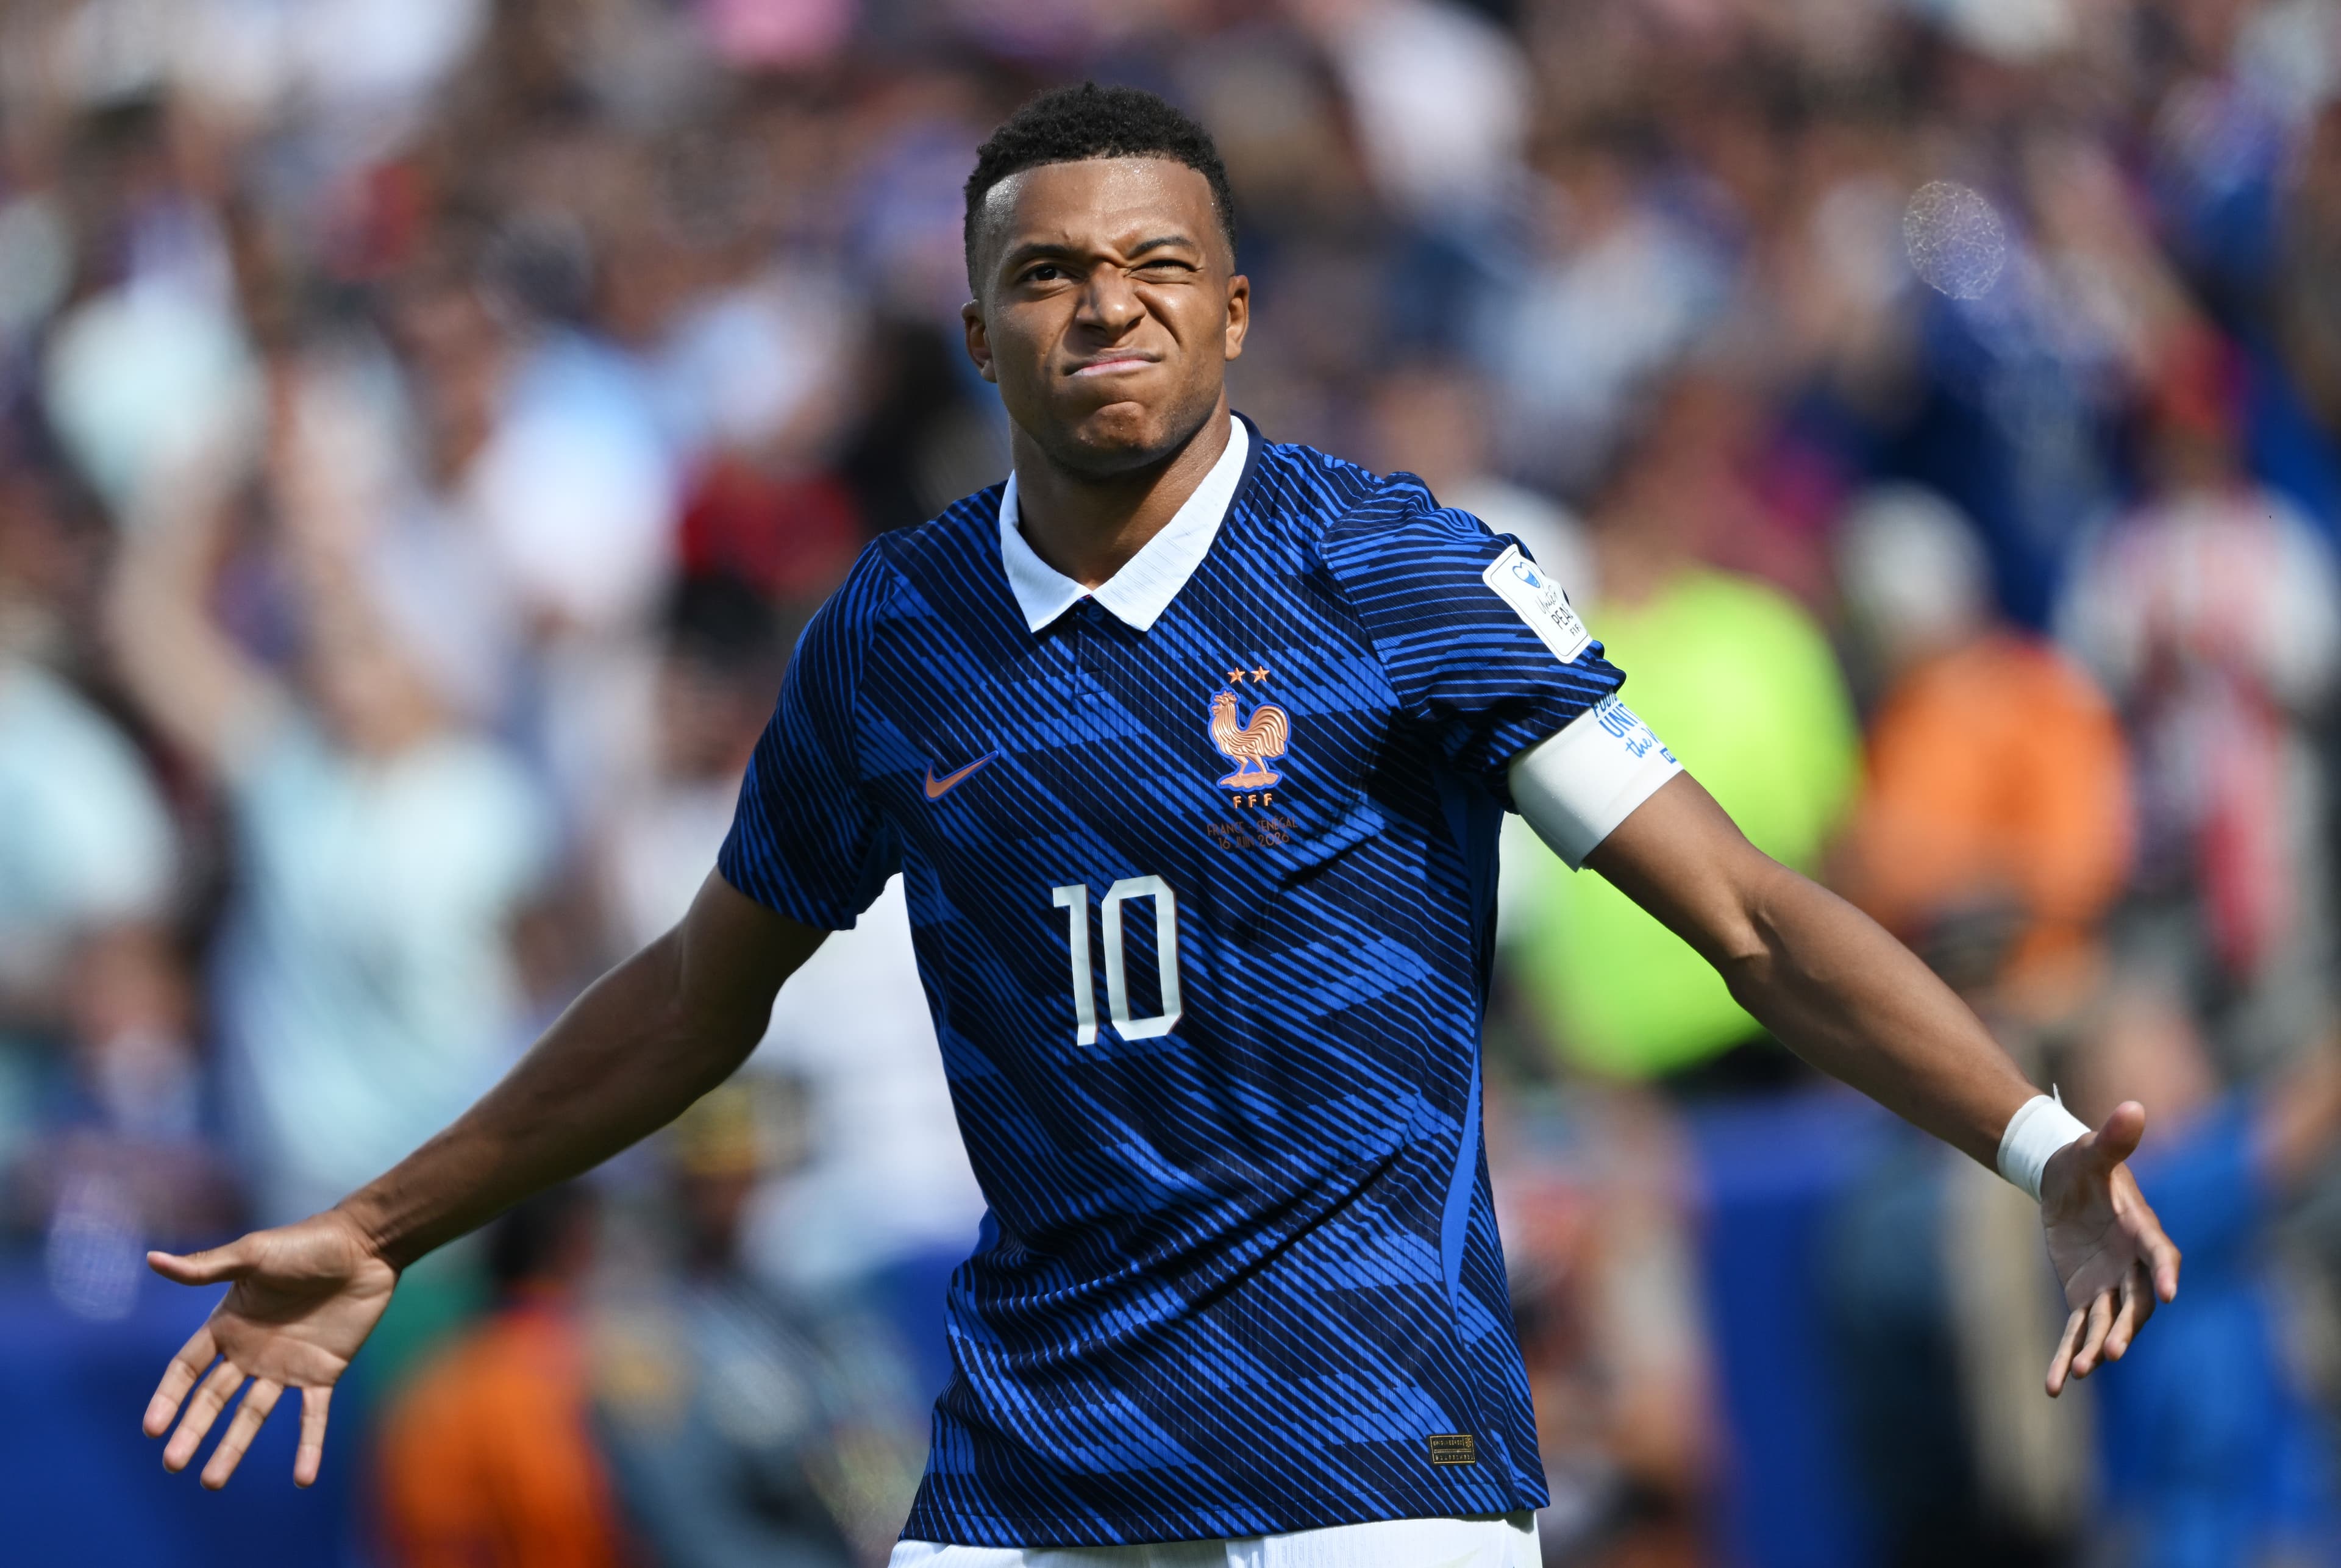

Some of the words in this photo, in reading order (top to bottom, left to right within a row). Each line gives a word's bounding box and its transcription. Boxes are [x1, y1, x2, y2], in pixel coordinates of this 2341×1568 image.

[1625, 736, 1652, 758] the
[1206, 821, 1244, 836] FRANCE
[1256, 816, 1298, 833] SÉNÉGAL
[1219, 836, 1231, 850] 16
[1236, 836, 1255, 848] JUIN
[1258, 832, 1290, 847] 2026
[1052, 874, 1184, 1047] 10
